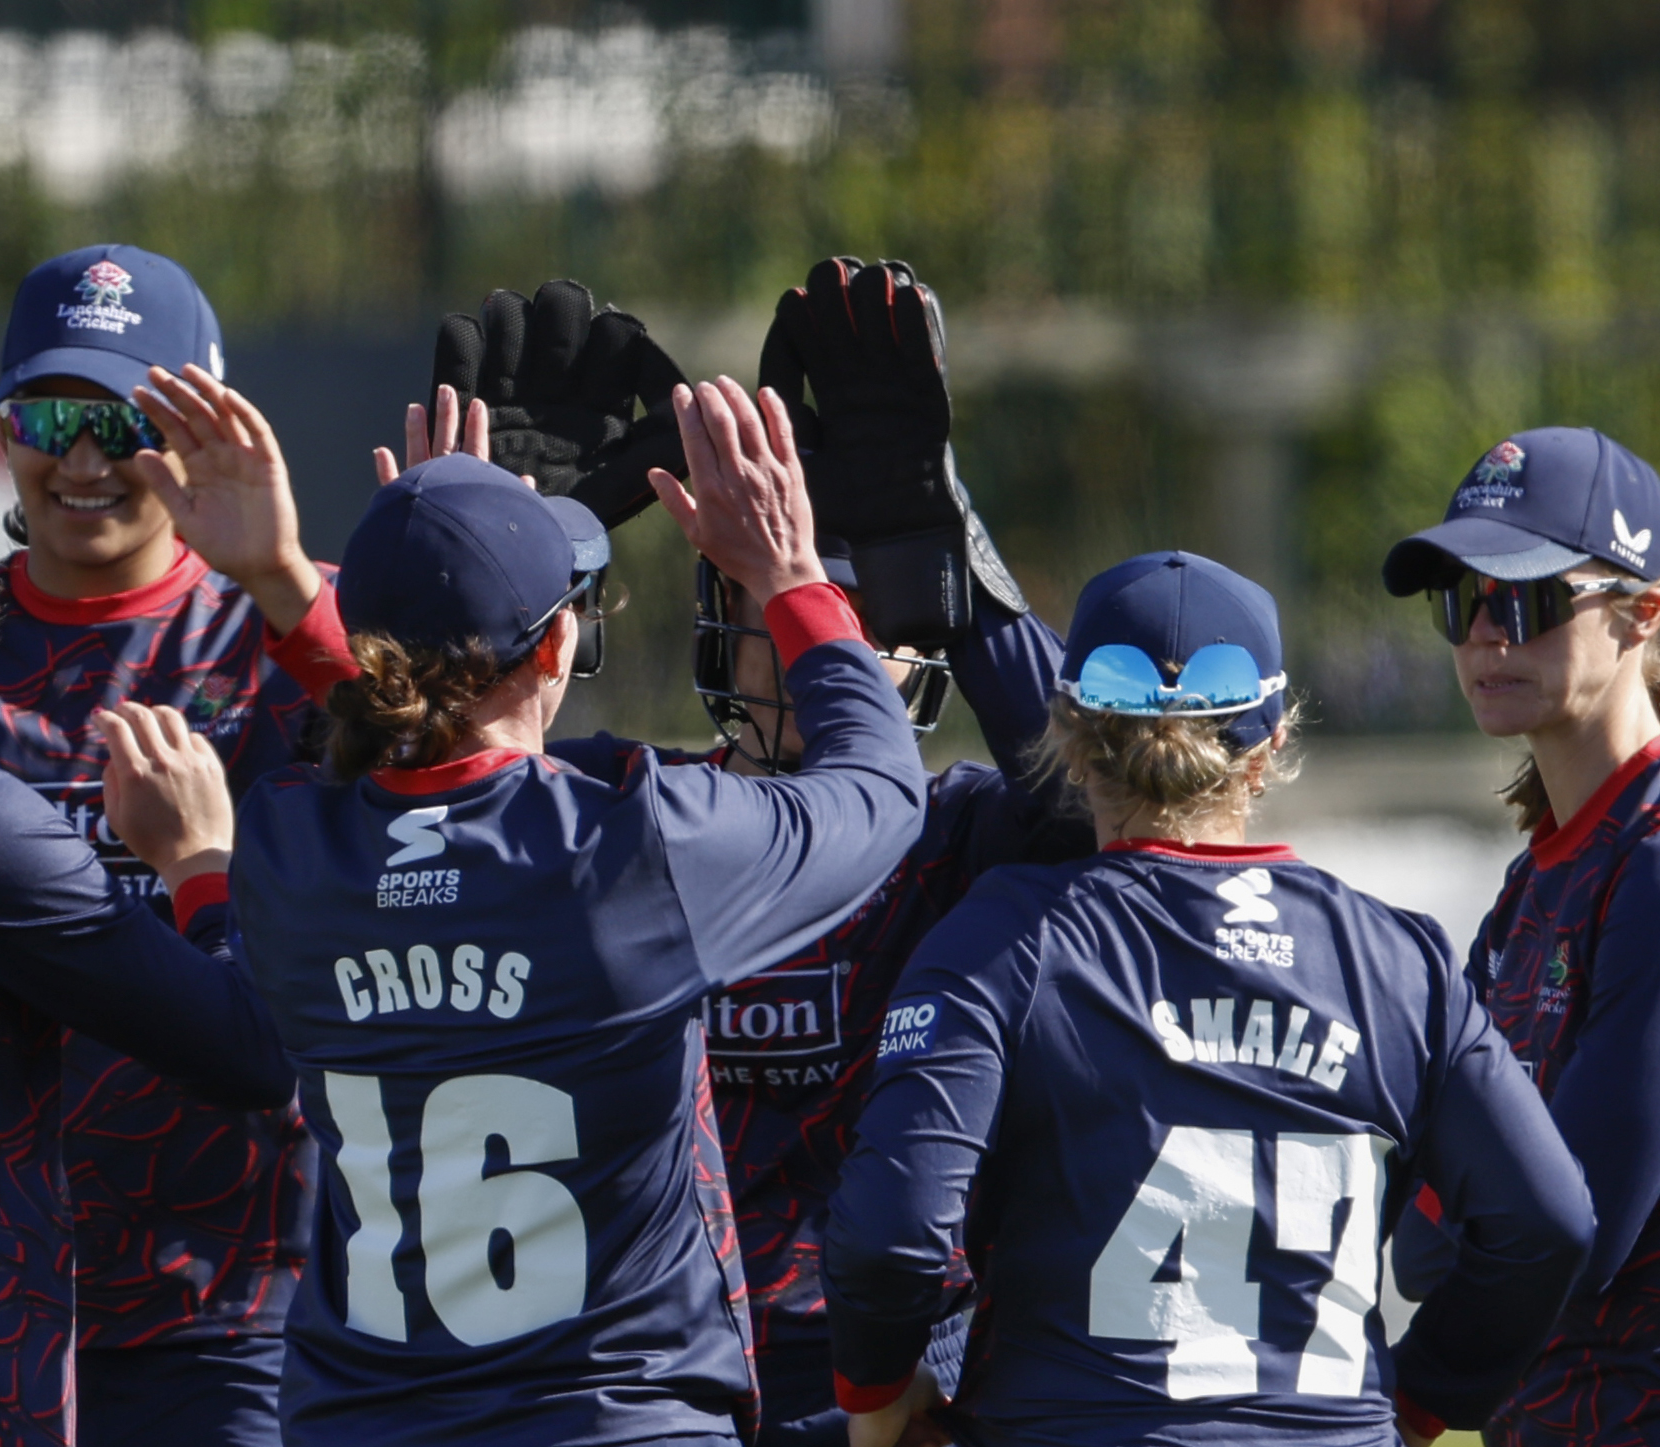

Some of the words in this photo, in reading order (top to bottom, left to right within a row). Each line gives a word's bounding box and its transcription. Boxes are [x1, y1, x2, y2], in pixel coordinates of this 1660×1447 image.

[376, 868, 461, 891] SPORTS
[376, 886, 459, 909] BREAKS
[1215, 927, 1294, 951] SPORTS
[1215, 943, 1294, 968] BREAKS
[333, 943, 532, 1023] CROSS
[701, 995, 821, 1040] lton
[882, 1003, 936, 1036] TRO
[1151, 997, 1361, 1092] SMALE
[710, 1065, 753, 1084] HE
[764, 1061, 839, 1086] STAY
[323, 1069, 587, 1347] 16
[1088, 1125, 1397, 1400] 47
